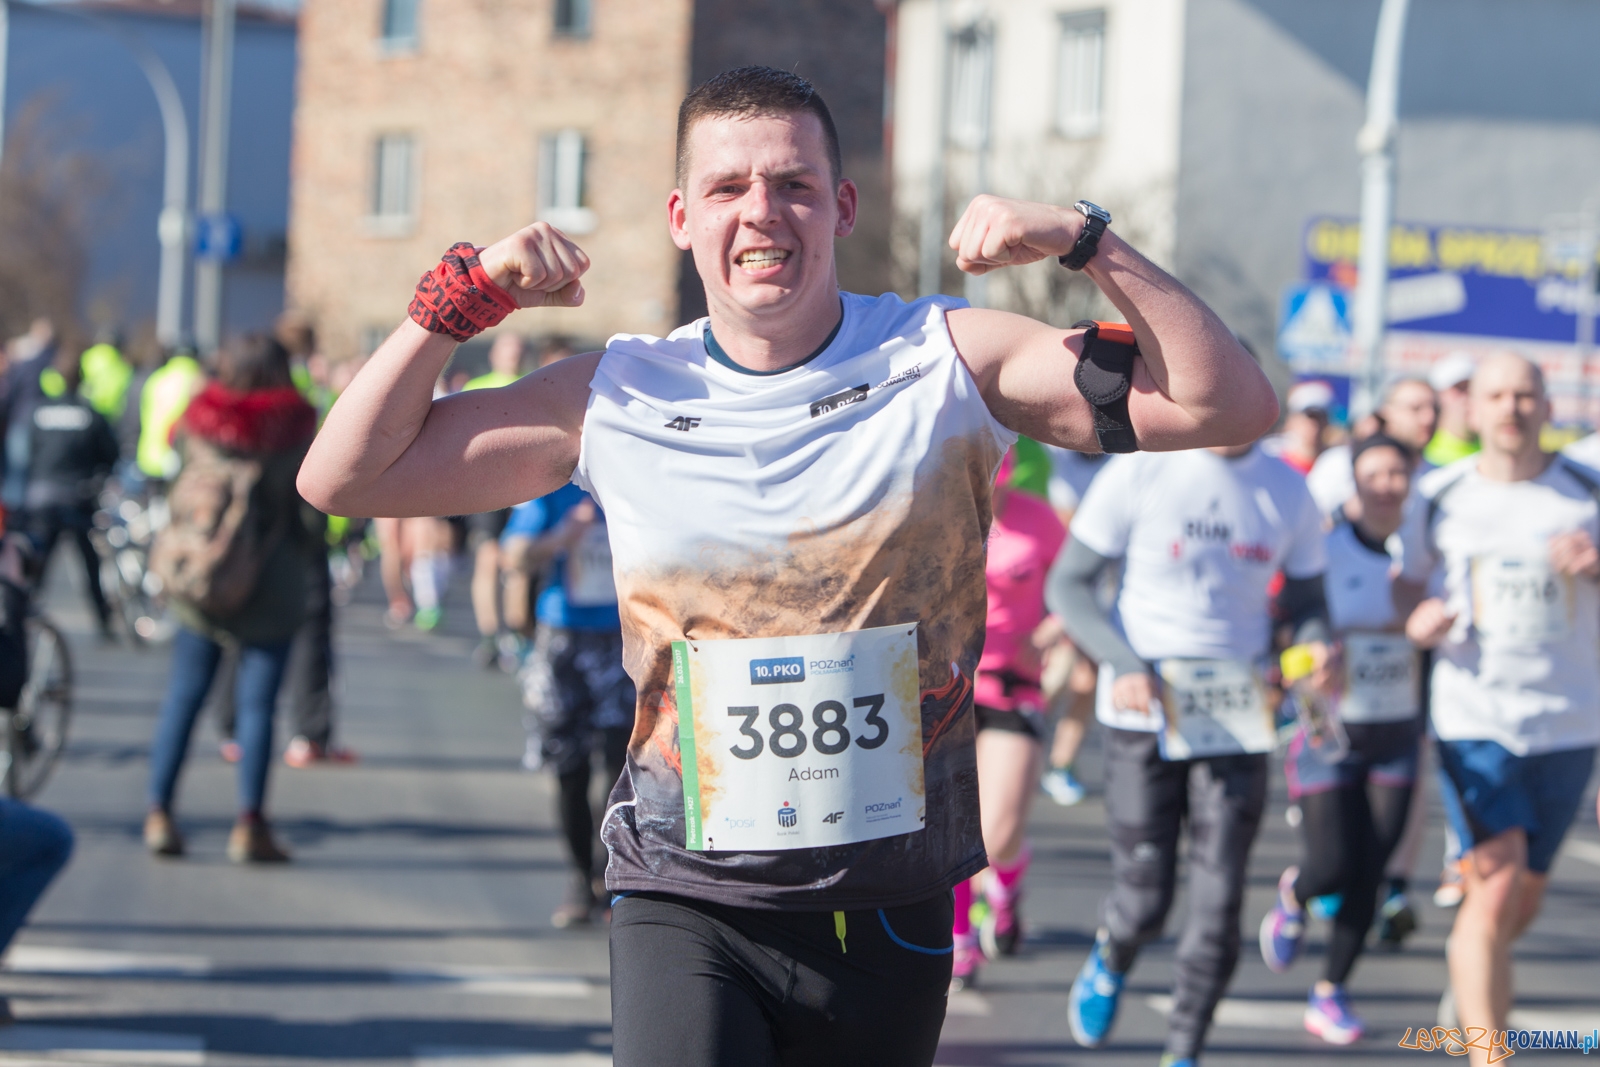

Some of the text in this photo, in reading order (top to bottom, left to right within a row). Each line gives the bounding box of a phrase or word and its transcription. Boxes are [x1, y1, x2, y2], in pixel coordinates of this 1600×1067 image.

[664, 416, 701, 432] 4F
[675, 649, 684, 684] 26.03.2017
[755, 664, 801, 677] 10. PKO
[727, 693, 889, 760] 3883
[788, 767, 839, 782] Adam
[823, 811, 844, 824] 4F
